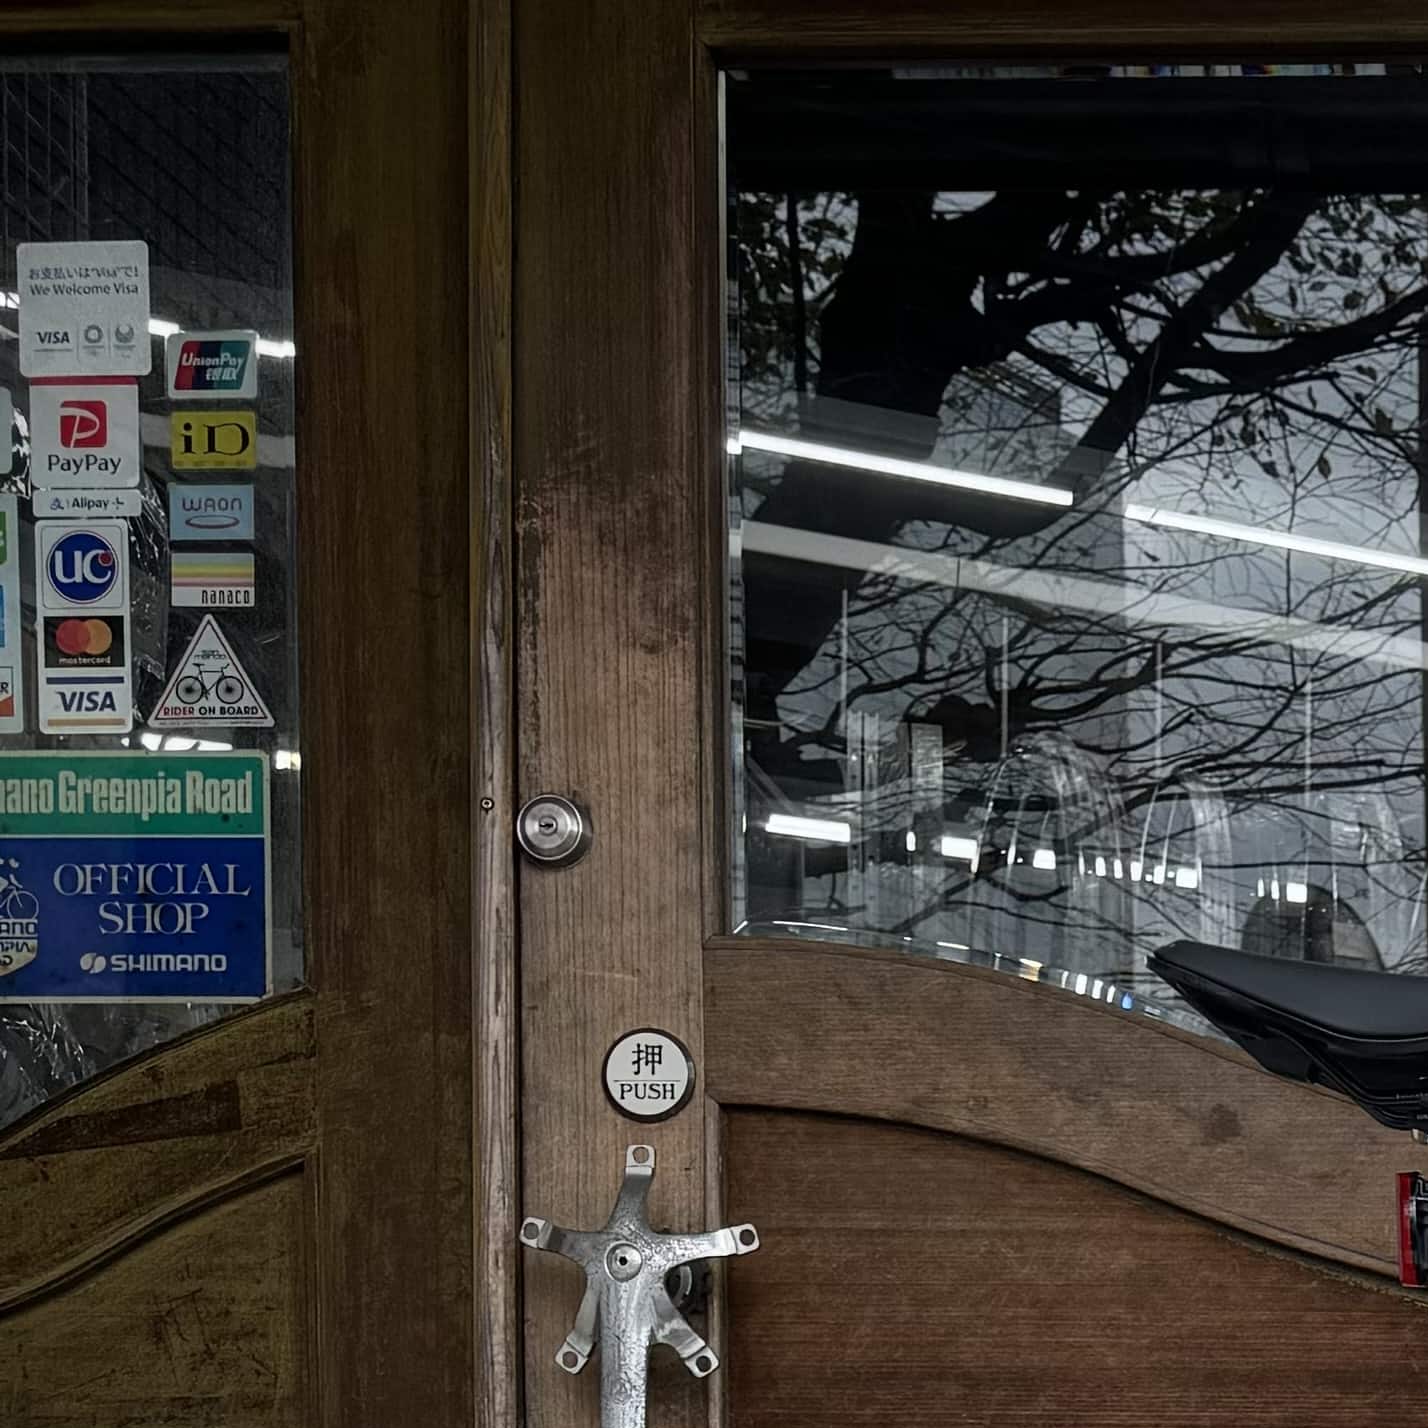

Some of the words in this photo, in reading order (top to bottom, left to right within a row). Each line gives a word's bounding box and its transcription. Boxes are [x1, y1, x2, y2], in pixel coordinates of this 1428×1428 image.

[30, 284, 51, 296] We
[52, 283, 112, 296] Welcome
[113, 282, 139, 295] Visa
[36, 331, 70, 344] VISA
[182, 352, 245, 372] UnionPay
[181, 422, 250, 456] iD
[48, 454, 122, 475] PayPay
[54, 550, 112, 584] UC
[202, 589, 250, 605] nanaco
[59, 656, 111, 665] mastercard
[56, 691, 117, 712] VISA
[163, 706, 195, 715] RIDER
[219, 705, 258, 715] BOARD
[58, 770, 182, 821] Greenpia
[185, 770, 253, 814] Road
[53, 863, 251, 896] OFFICIAL
[99, 902, 209, 935] SHOP
[111, 953, 227, 972] SHIMANO
[631, 1042, 663, 1076] 押
[619, 1083, 676, 1100] PUSH
